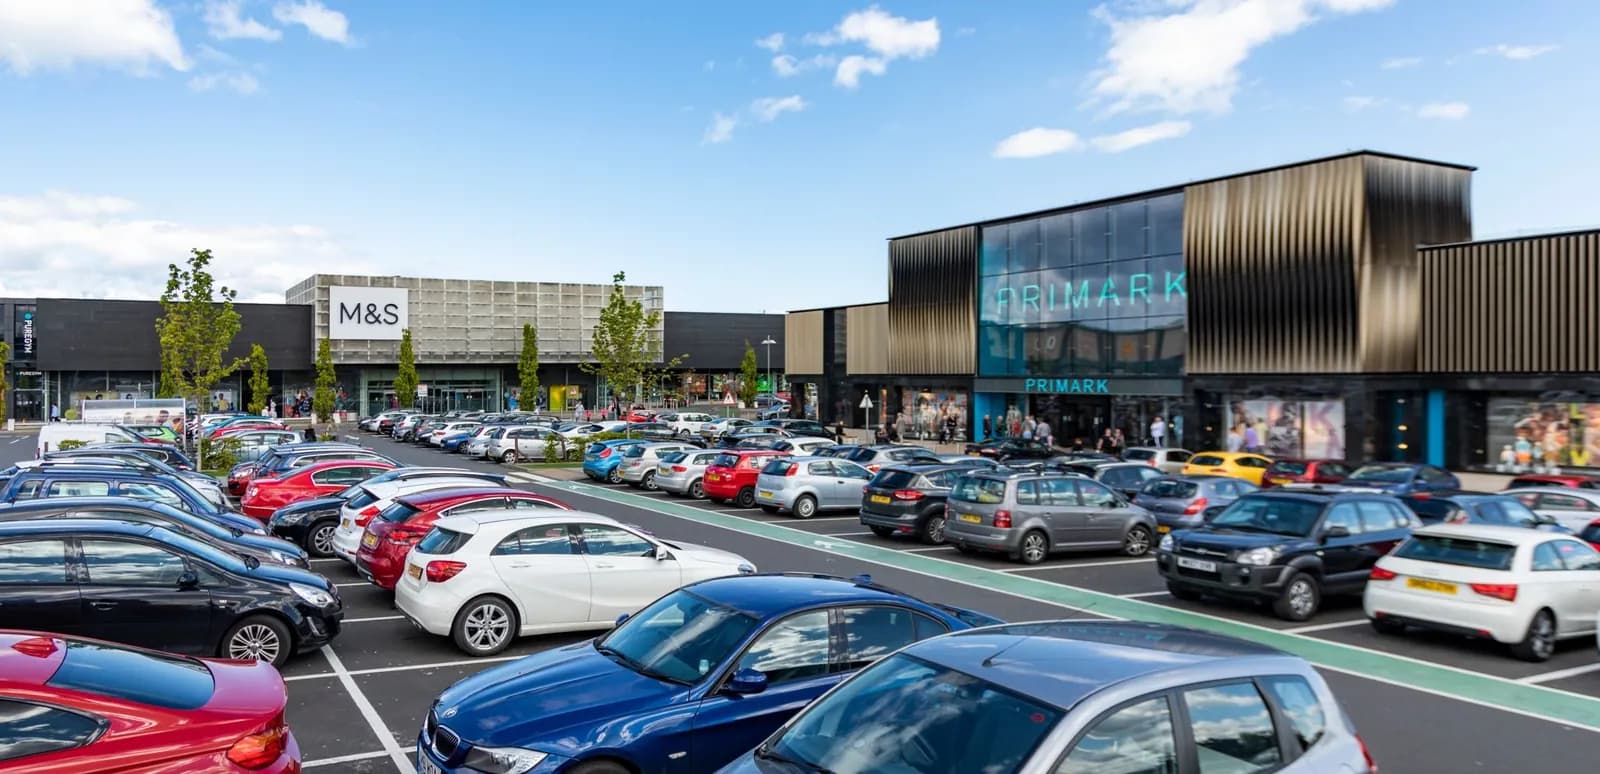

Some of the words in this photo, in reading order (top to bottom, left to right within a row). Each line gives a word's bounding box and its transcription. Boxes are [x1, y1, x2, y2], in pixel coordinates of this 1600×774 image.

[997, 272, 1187, 313] PRIMARK
[339, 302, 399, 325] M&S
[24, 320, 32, 353] PUREGYM
[1025, 379, 1109, 393] PRIMARK
